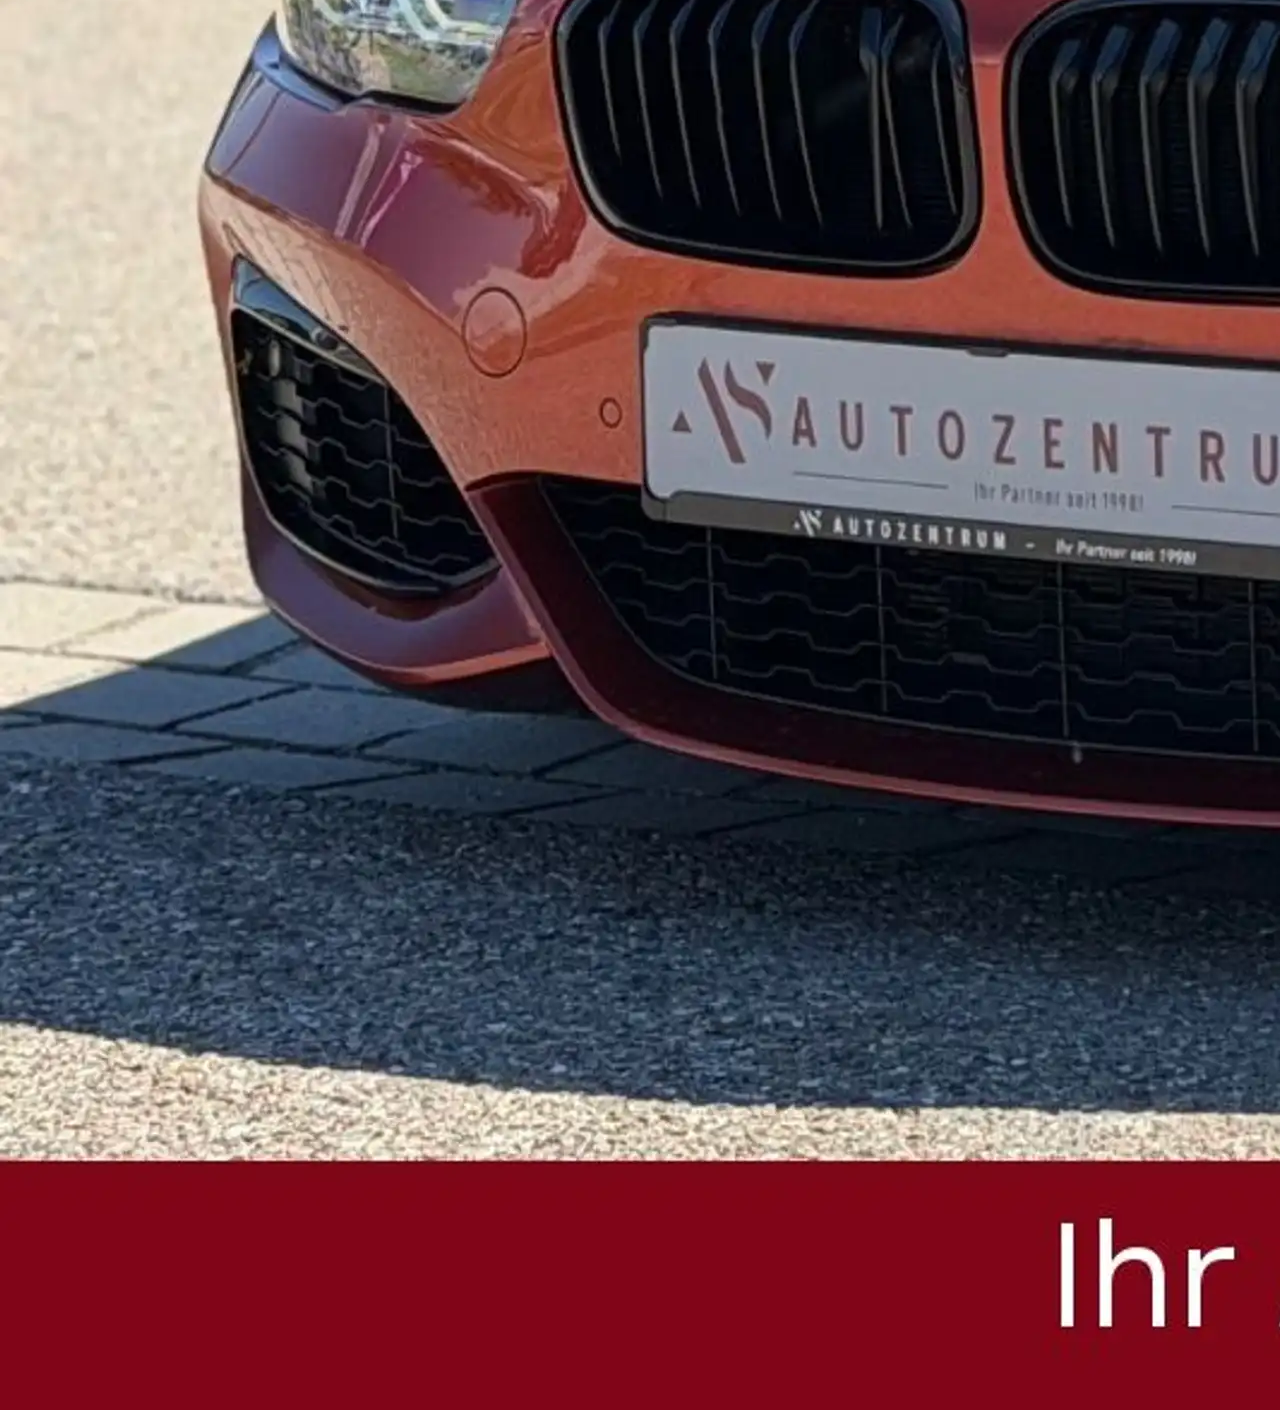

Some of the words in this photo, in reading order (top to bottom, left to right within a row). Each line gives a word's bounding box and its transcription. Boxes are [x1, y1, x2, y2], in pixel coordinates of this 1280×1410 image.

[974, 481, 996, 503] Ihr
[1001, 483, 1060, 507] Partner
[1065, 490, 1097, 510] seit
[833, 514, 1006, 551] AUTOZENTRUM
[1055, 537, 1075, 556] Ihr
[1076, 539, 1128, 561] Partner
[1129, 547, 1156, 563] seit
